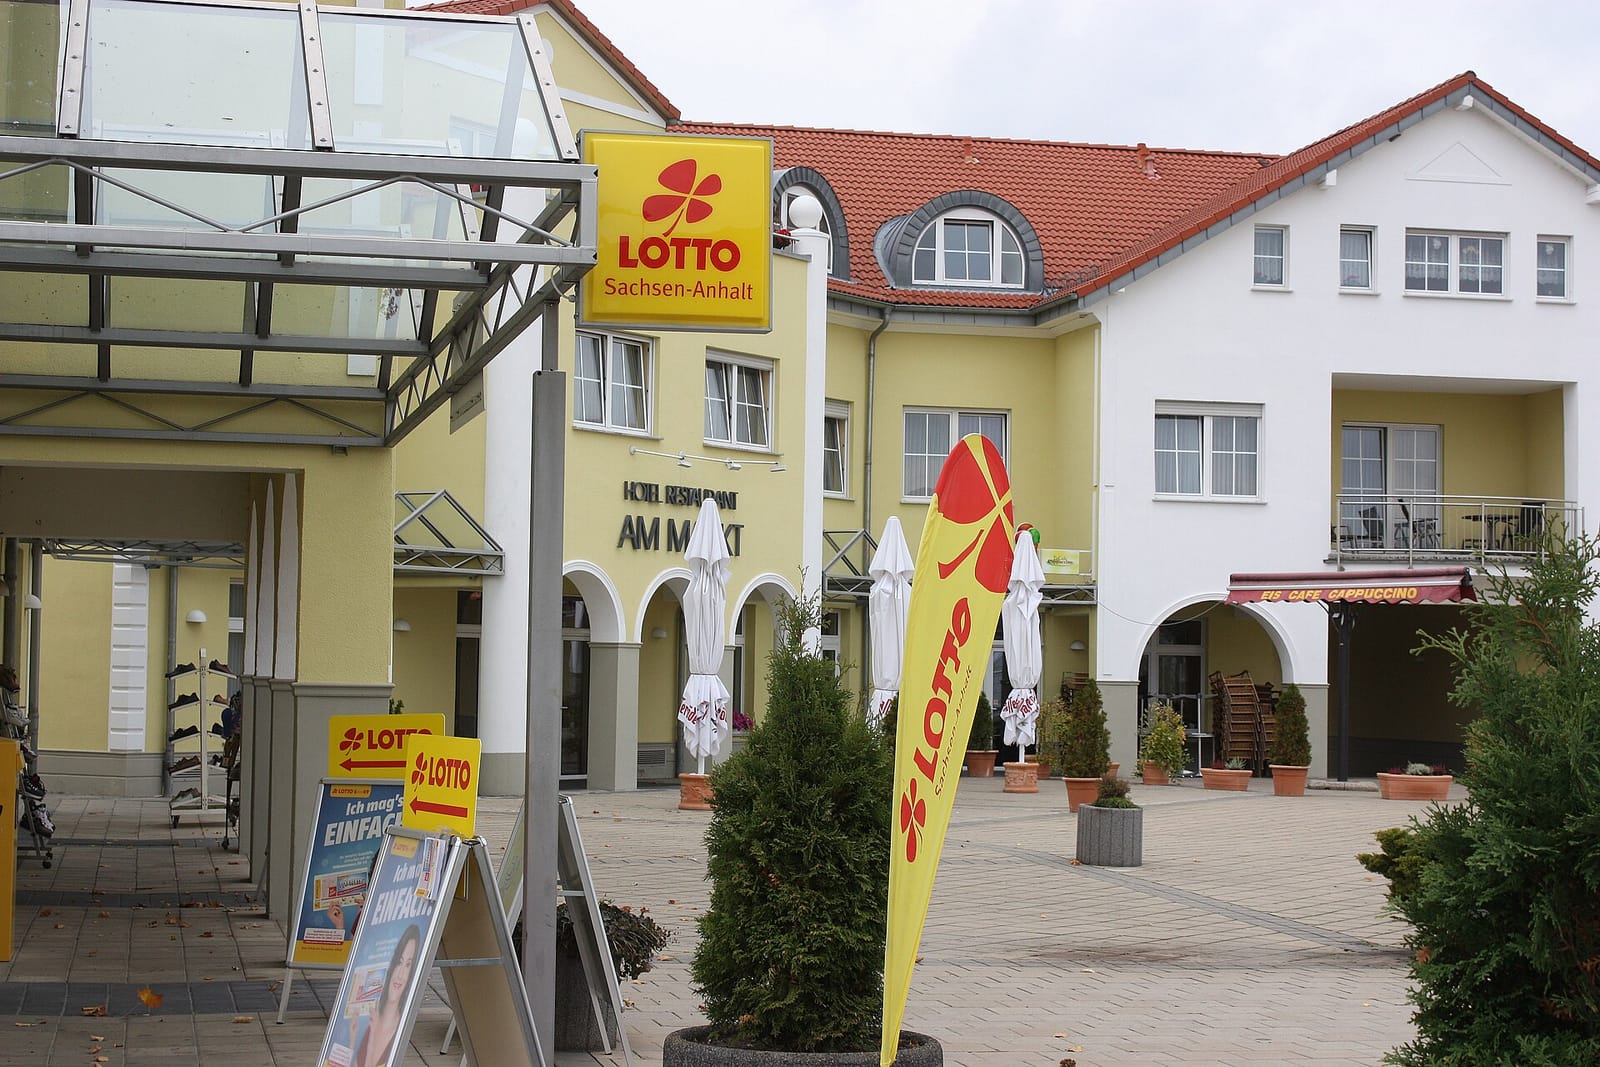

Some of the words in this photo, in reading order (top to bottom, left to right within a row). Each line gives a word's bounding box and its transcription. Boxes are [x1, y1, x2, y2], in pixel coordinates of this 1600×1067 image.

[618, 235, 741, 272] LOTTO
[604, 277, 753, 300] Sachsen-Anhalt
[623, 481, 663, 504] HOTEL
[616, 514, 660, 551] AM
[667, 518, 745, 557] MKT
[1261, 590, 1282, 600] EIS
[1288, 589, 1322, 600] CAFE
[1328, 587, 1418, 599] CAPPUCCINO
[913, 597, 971, 783] LOTTO
[367, 728, 433, 750] LOT
[934, 664, 973, 800] Sachsen-Anhalt
[428, 756, 471, 791] LOTTO
[345, 800, 365, 816] Ich
[366, 793, 404, 812] mag's
